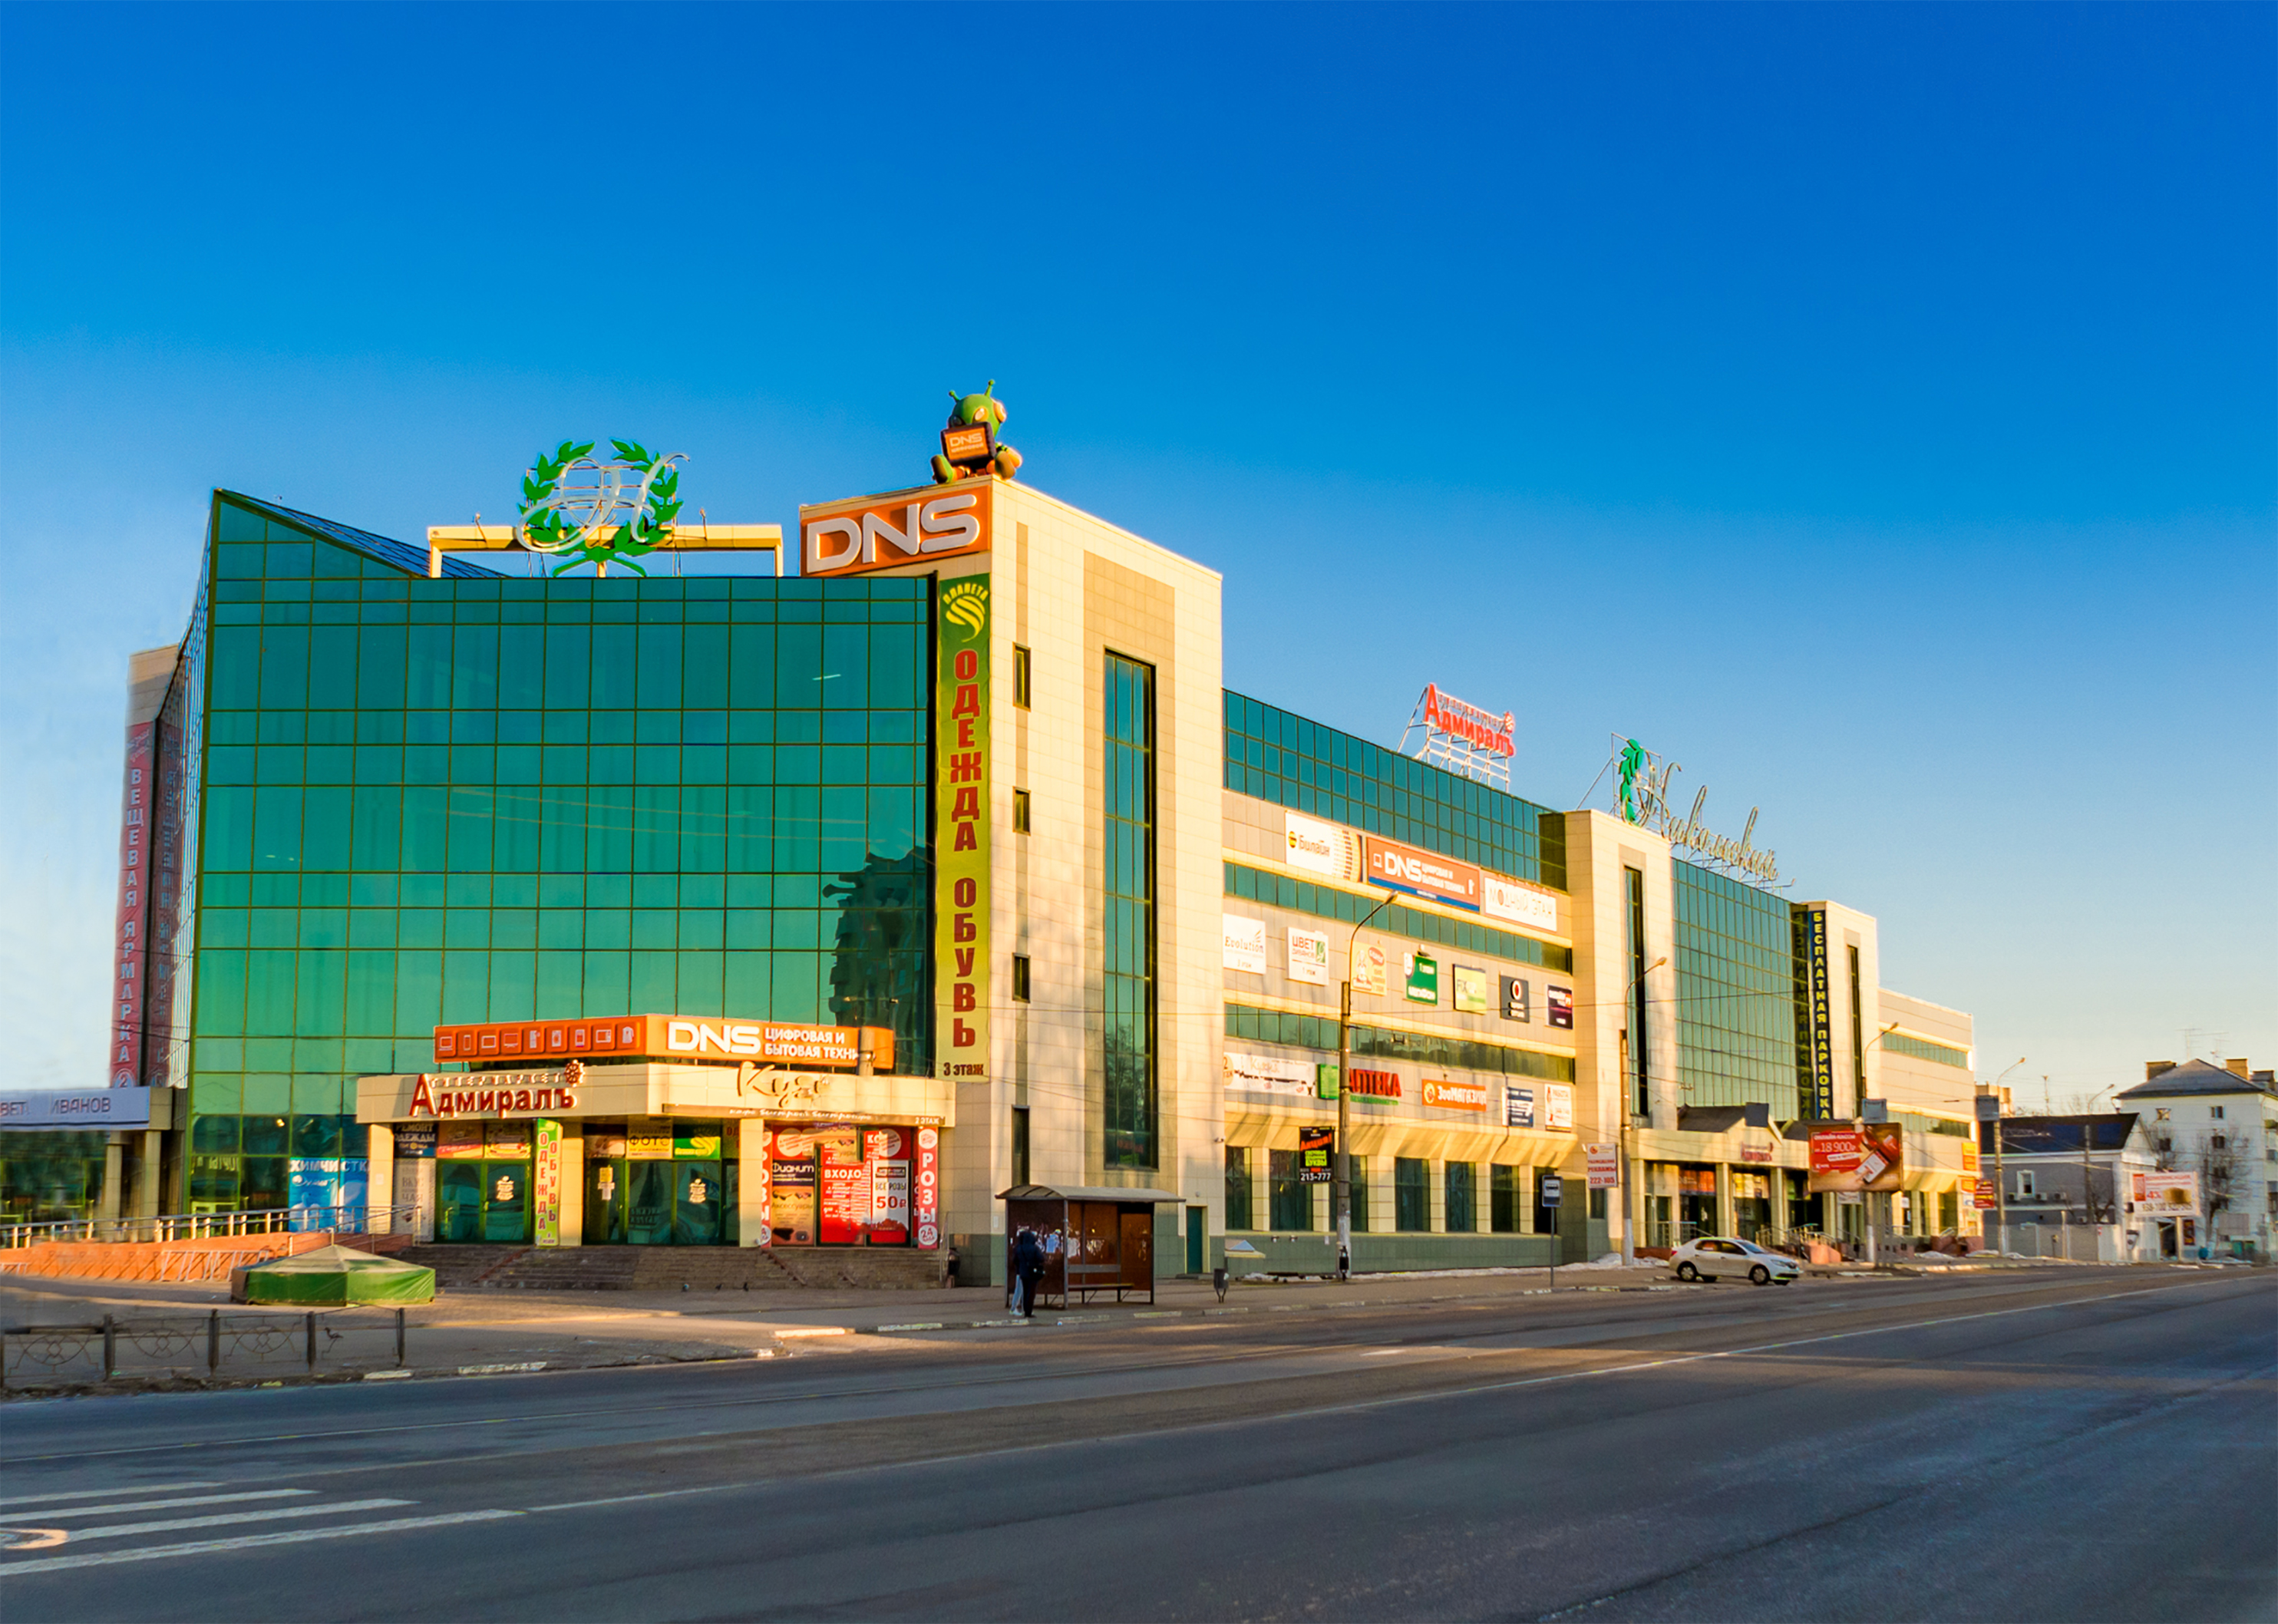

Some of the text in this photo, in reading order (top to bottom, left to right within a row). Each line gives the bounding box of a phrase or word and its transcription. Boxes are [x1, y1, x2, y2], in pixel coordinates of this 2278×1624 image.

[949, 433, 982, 447] DNS
[807, 494, 980, 573] DNS
[943, 583, 989, 605] ПЛАНЕТА
[1425, 683, 1514, 756] Адмиралъ
[125, 768, 144, 908] ВЕЩЕВАЯ
[950, 649, 982, 1048] ОДЕЖДА ОБУВЬ
[1385, 851, 1422, 883] DNS
[1292, 935, 1315, 950] ЦВЕТ
[118, 920, 136, 1062] ЯРМАРКА
[1813, 913, 1830, 1119] БЕСПЛАТНАЯ ПАРКОВКА
[668, 1022, 761, 1055] DNS
[764, 1027, 845, 1045] ЦИФРОВАЯ И
[764, 1043, 820, 1058] БЫТОВАЯ
[943, 1062, 984, 1076] 3 этаж
[409, 1073, 579, 1119] Адмиралъ
[395, 1124, 433, 1132] РЕМОНТ
[289, 1160, 370, 1173] ХИМЧИСТК
[537, 1133, 548, 1230] ОДЕЖДА
[548, 1141, 557, 1222] ОБУВЬ
[919, 1152, 936, 1223] РОЗЫ
